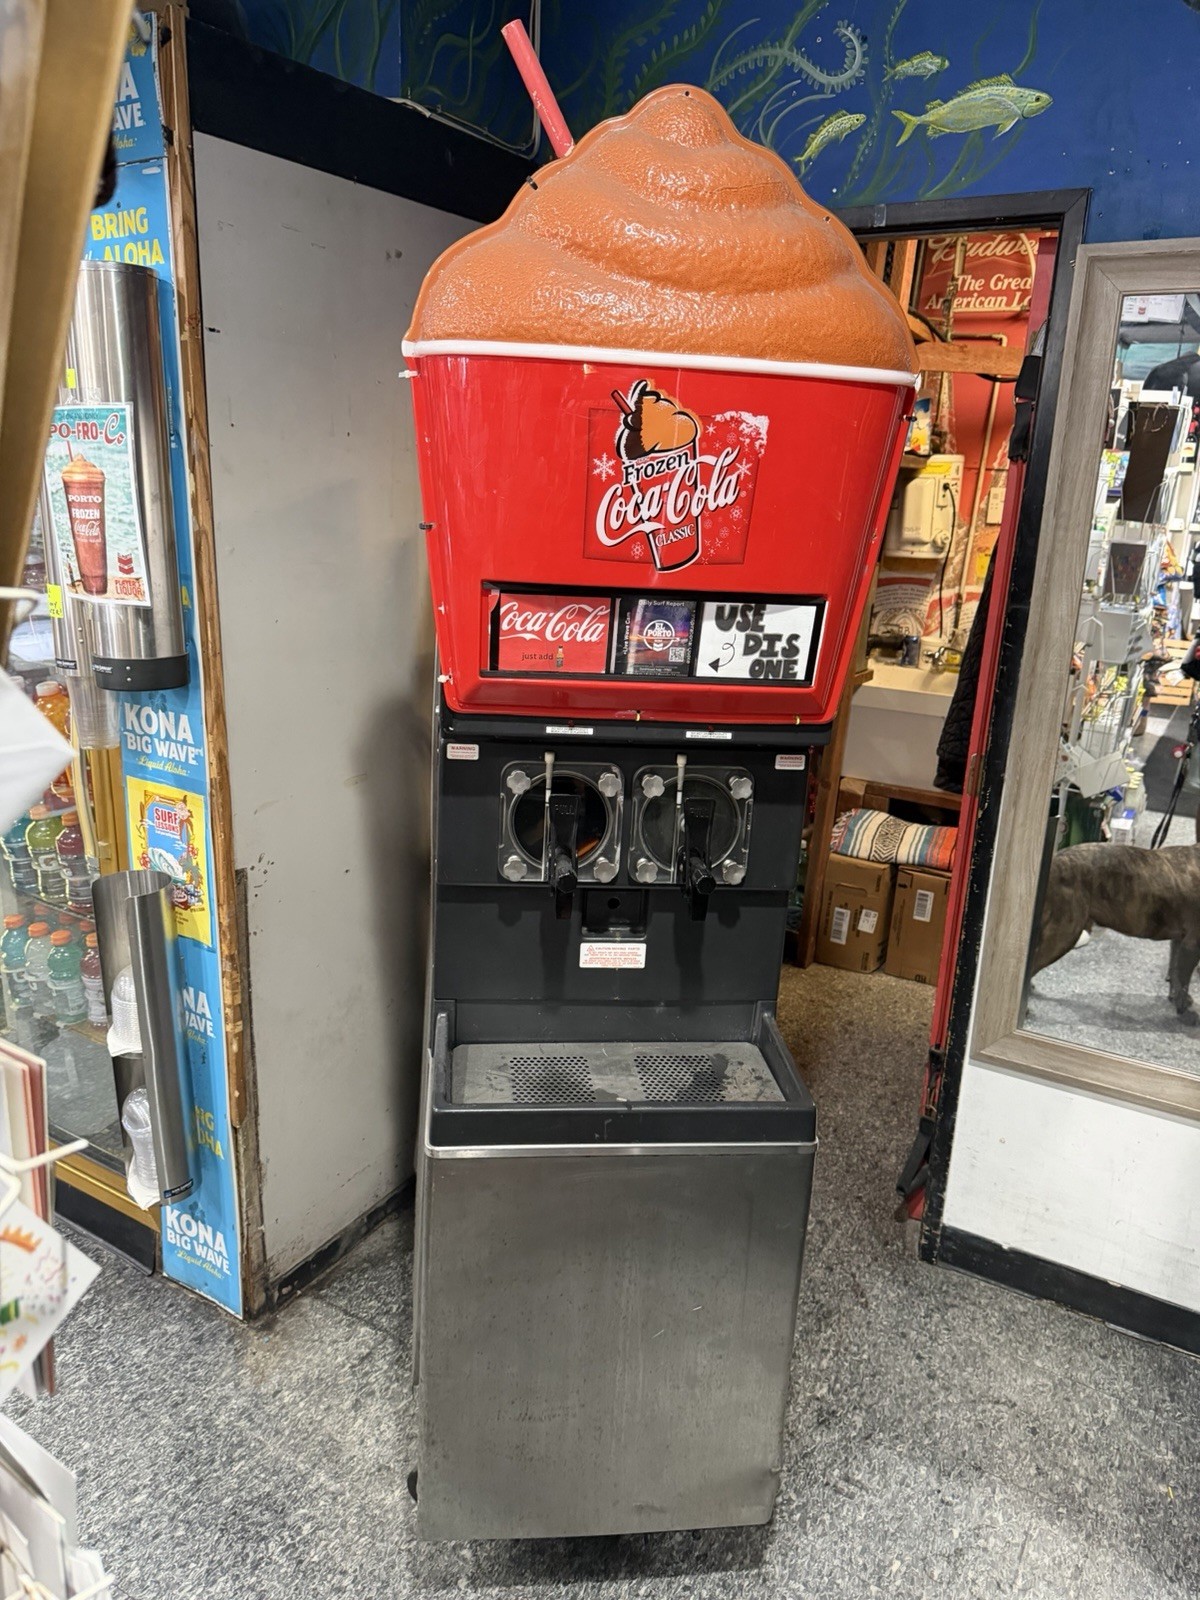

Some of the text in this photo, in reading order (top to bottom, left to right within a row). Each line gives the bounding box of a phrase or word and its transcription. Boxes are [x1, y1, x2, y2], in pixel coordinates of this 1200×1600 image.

[91, 206, 148, 241] BRING
[104, 238, 165, 266] ALOHA
[956, 274, 984, 291] The
[925, 292, 1008, 310] Aerican
[622, 450, 691, 486] Frozen
[67, 494, 103, 504] PORTO
[71, 507, 101, 519] FROZEN
[655, 523, 696, 548] CLASSIC
[666, 600, 685, 608] Report
[654, 622, 666, 631] EL
[714, 603, 767, 633] USE
[646, 629, 672, 638] PORTO
[521, 652, 554, 661] just add
[742, 633, 801, 659] DIS
[748, 658, 799, 679] ONE
[124, 701, 195, 744] KONA
[123, 731, 200, 766] BIG WAVE
[154, 807, 178, 825] SURF
[155, 820, 179, 834] LESSONS
[165, 1205, 230, 1260] KONA
[166, 1226, 232, 1276] BIG WAVE
